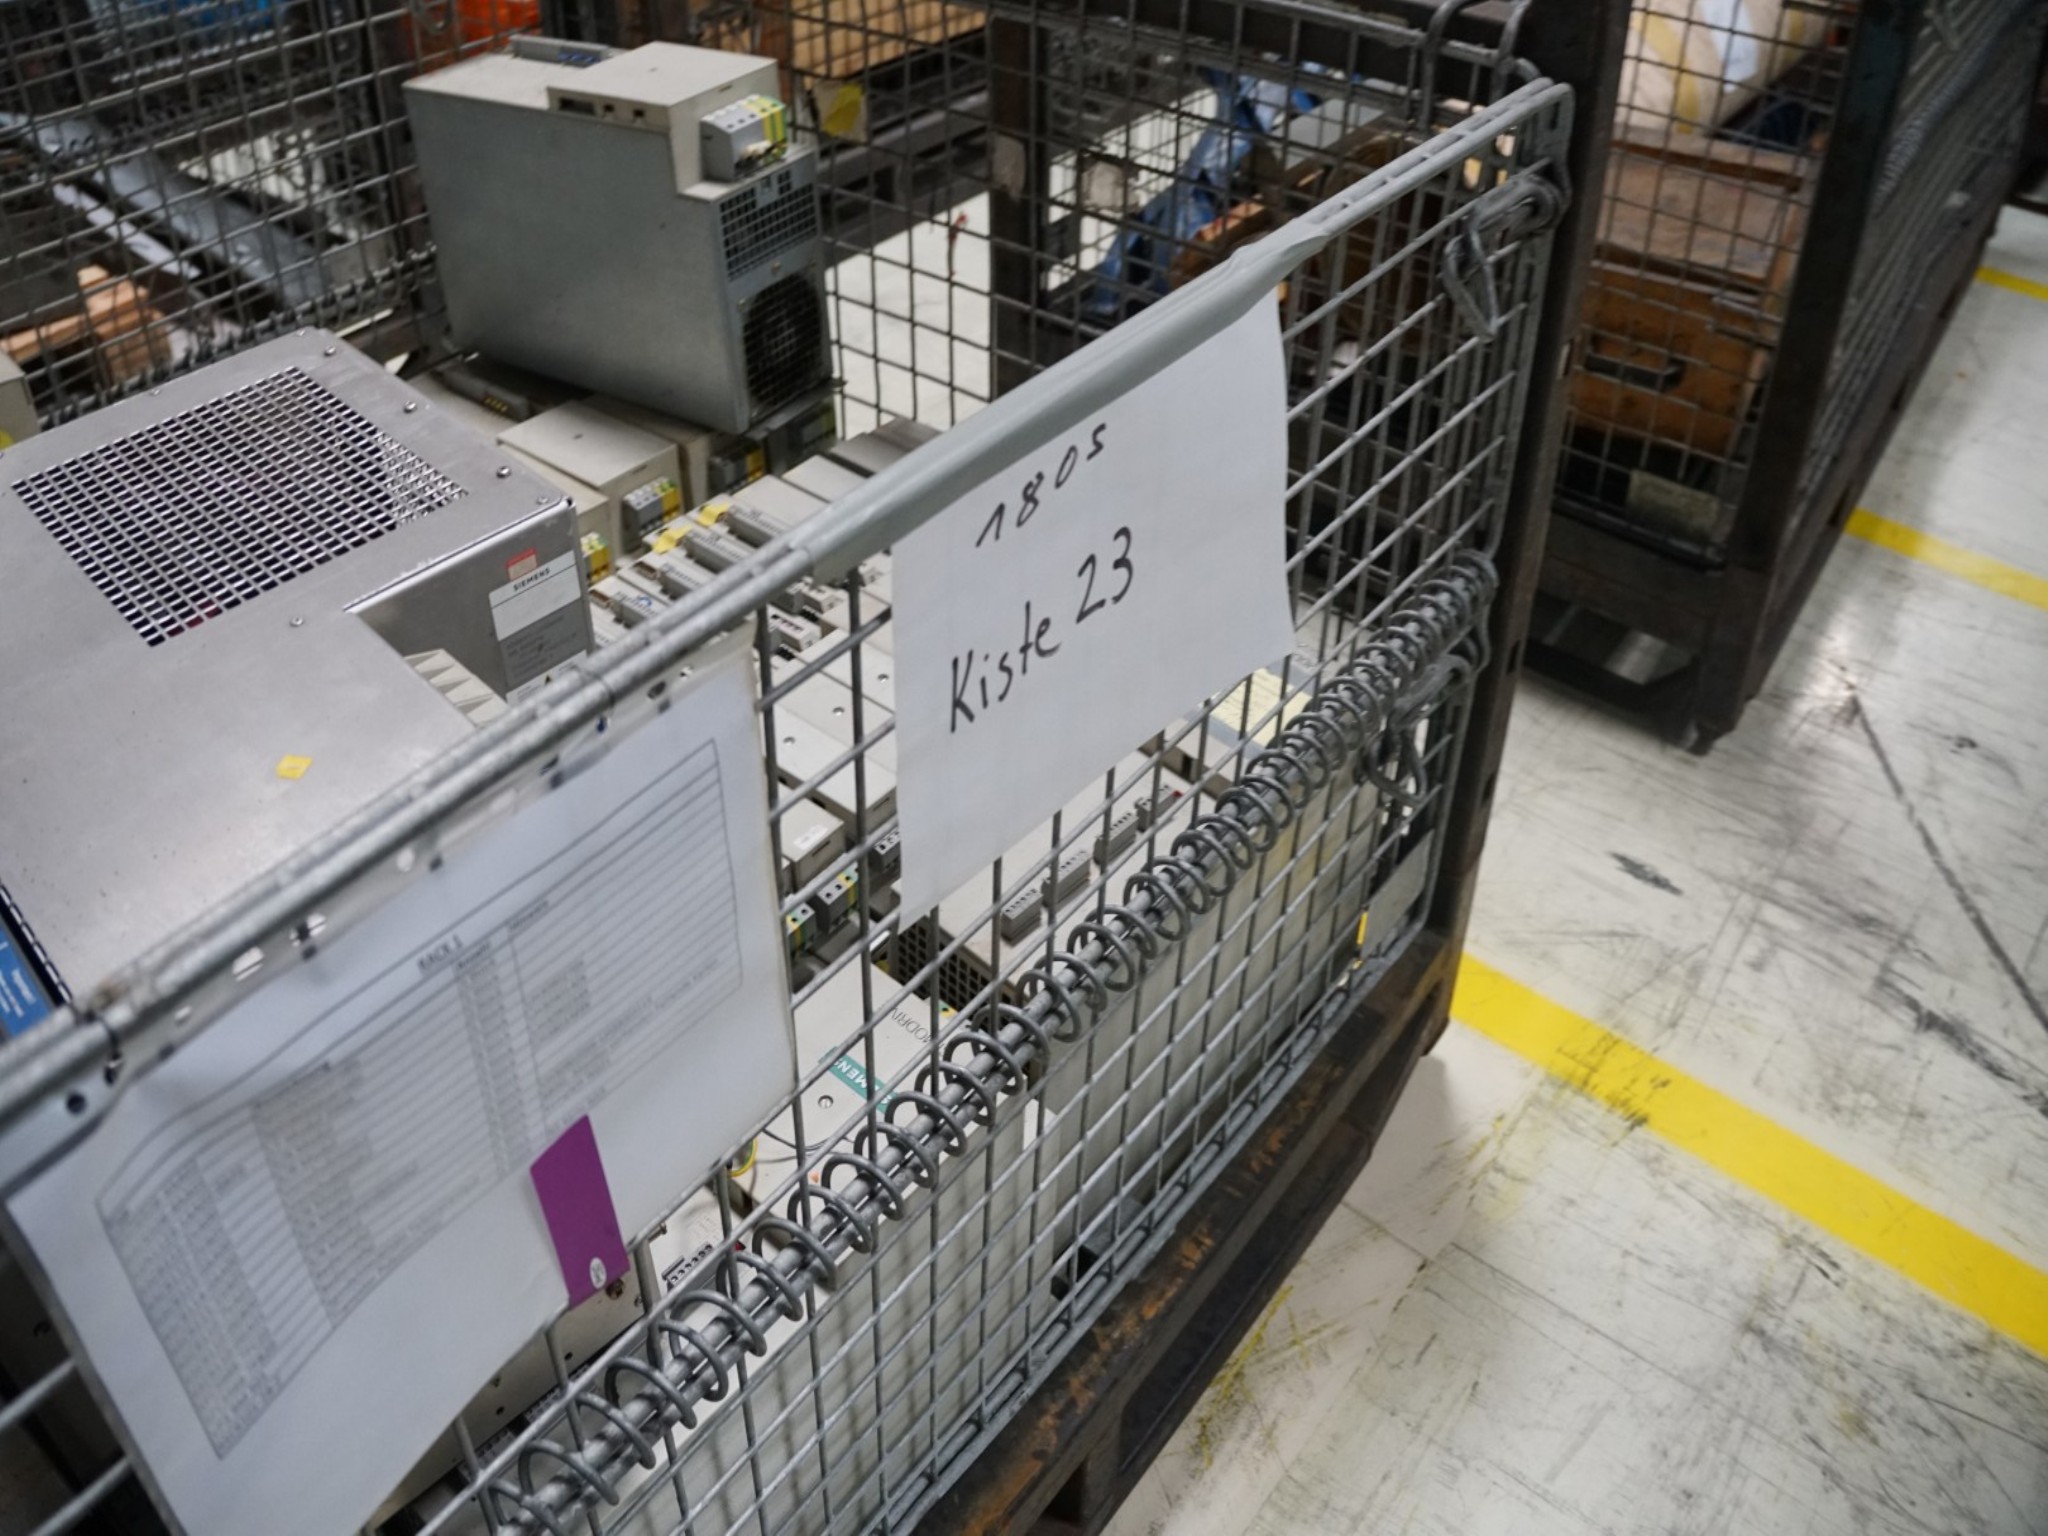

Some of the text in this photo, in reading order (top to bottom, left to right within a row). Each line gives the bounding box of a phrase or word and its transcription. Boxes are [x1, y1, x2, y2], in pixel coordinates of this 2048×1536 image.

[512, 567, 551, 592] SIEMENS
[950, 526, 1134, 733] Kiste 23
